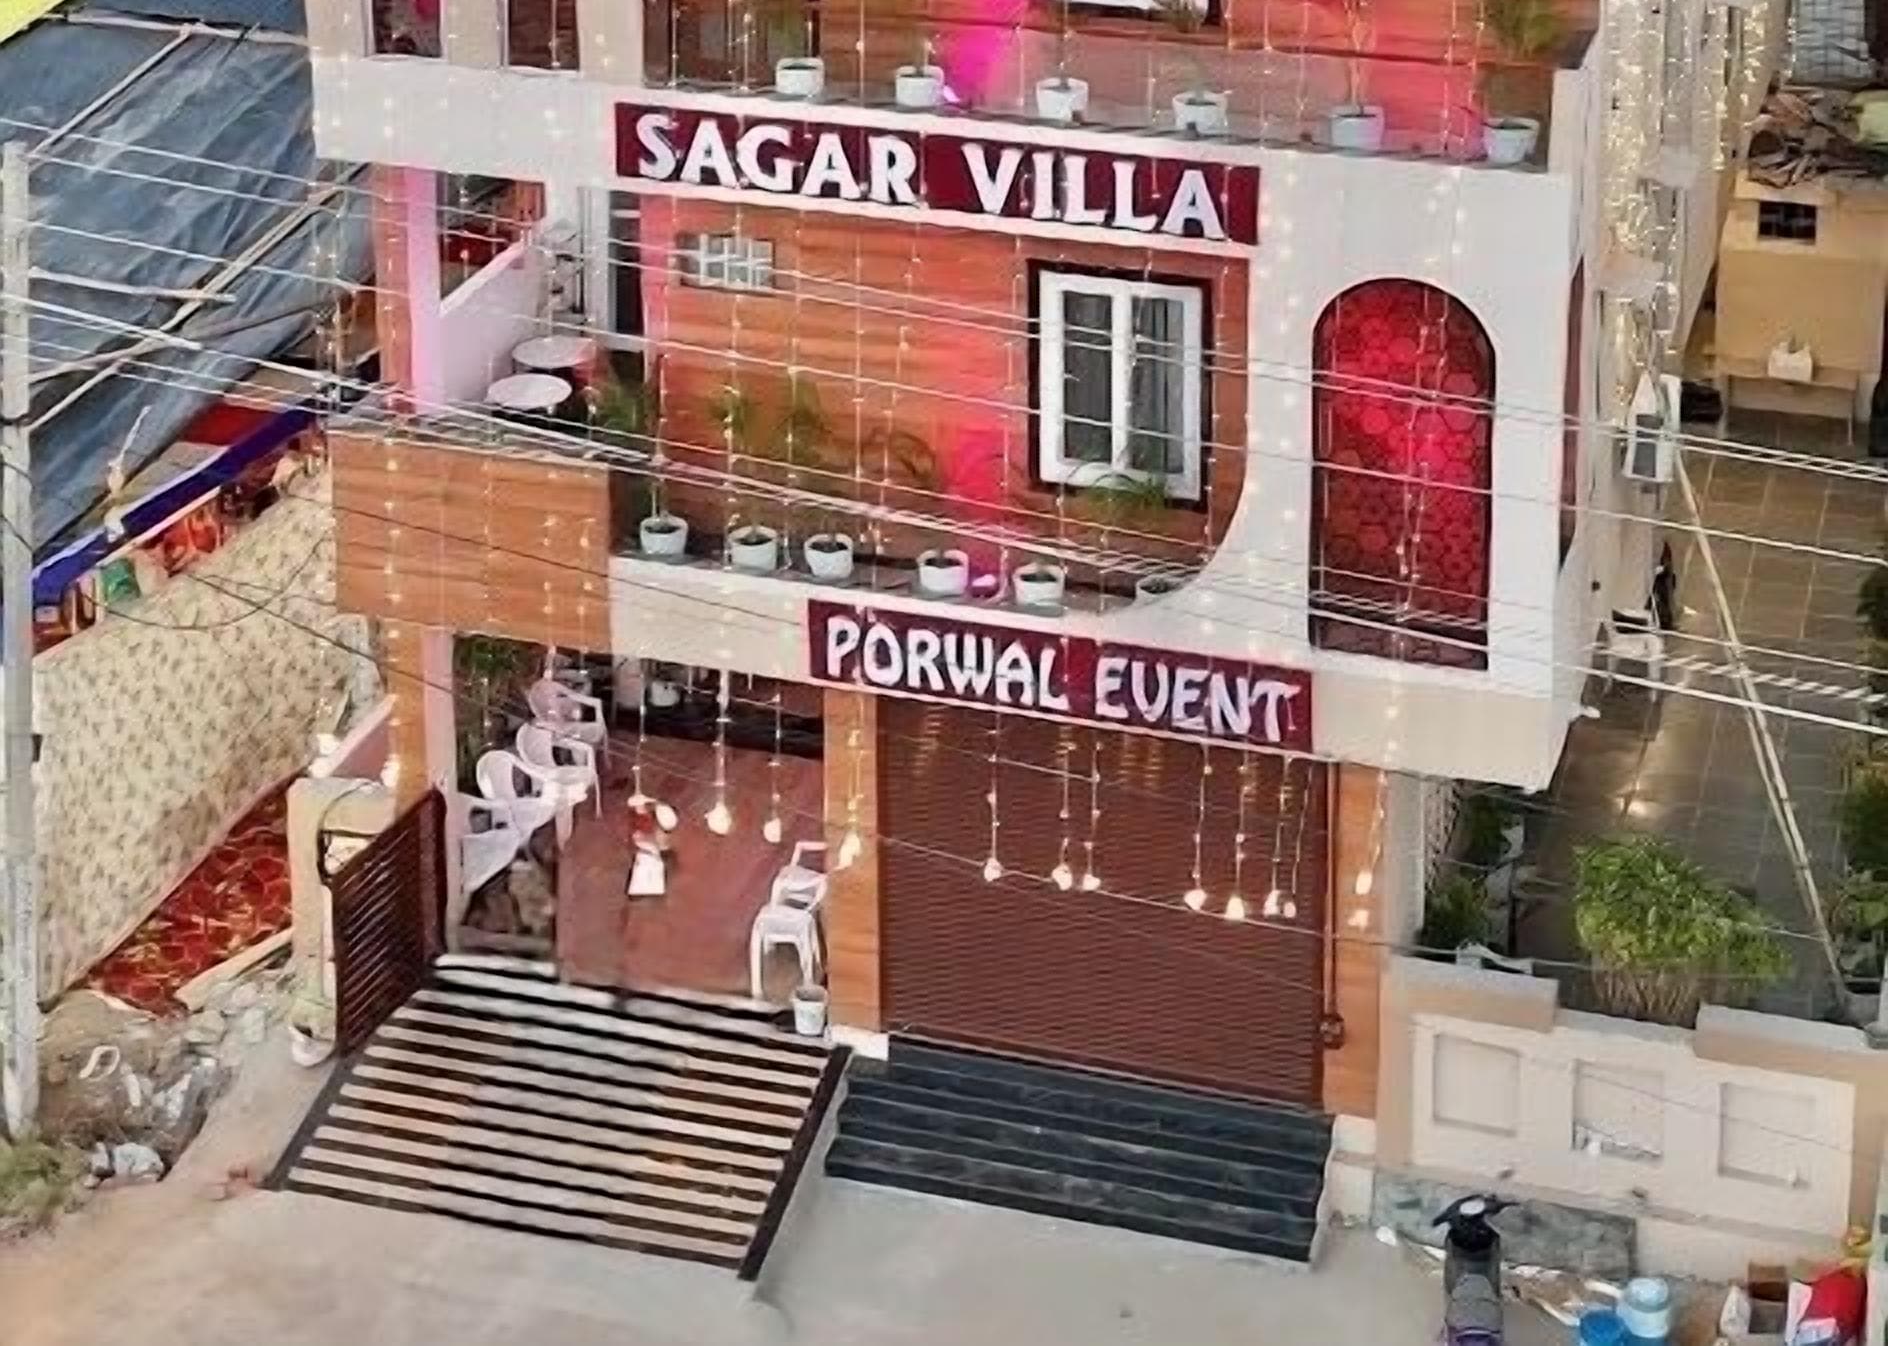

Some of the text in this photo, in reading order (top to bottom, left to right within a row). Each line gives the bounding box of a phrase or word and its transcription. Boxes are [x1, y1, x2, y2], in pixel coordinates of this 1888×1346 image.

[635, 112, 1227, 240] SAGAR VILLA
[826, 615, 1301, 742] PORWAL EVENT
